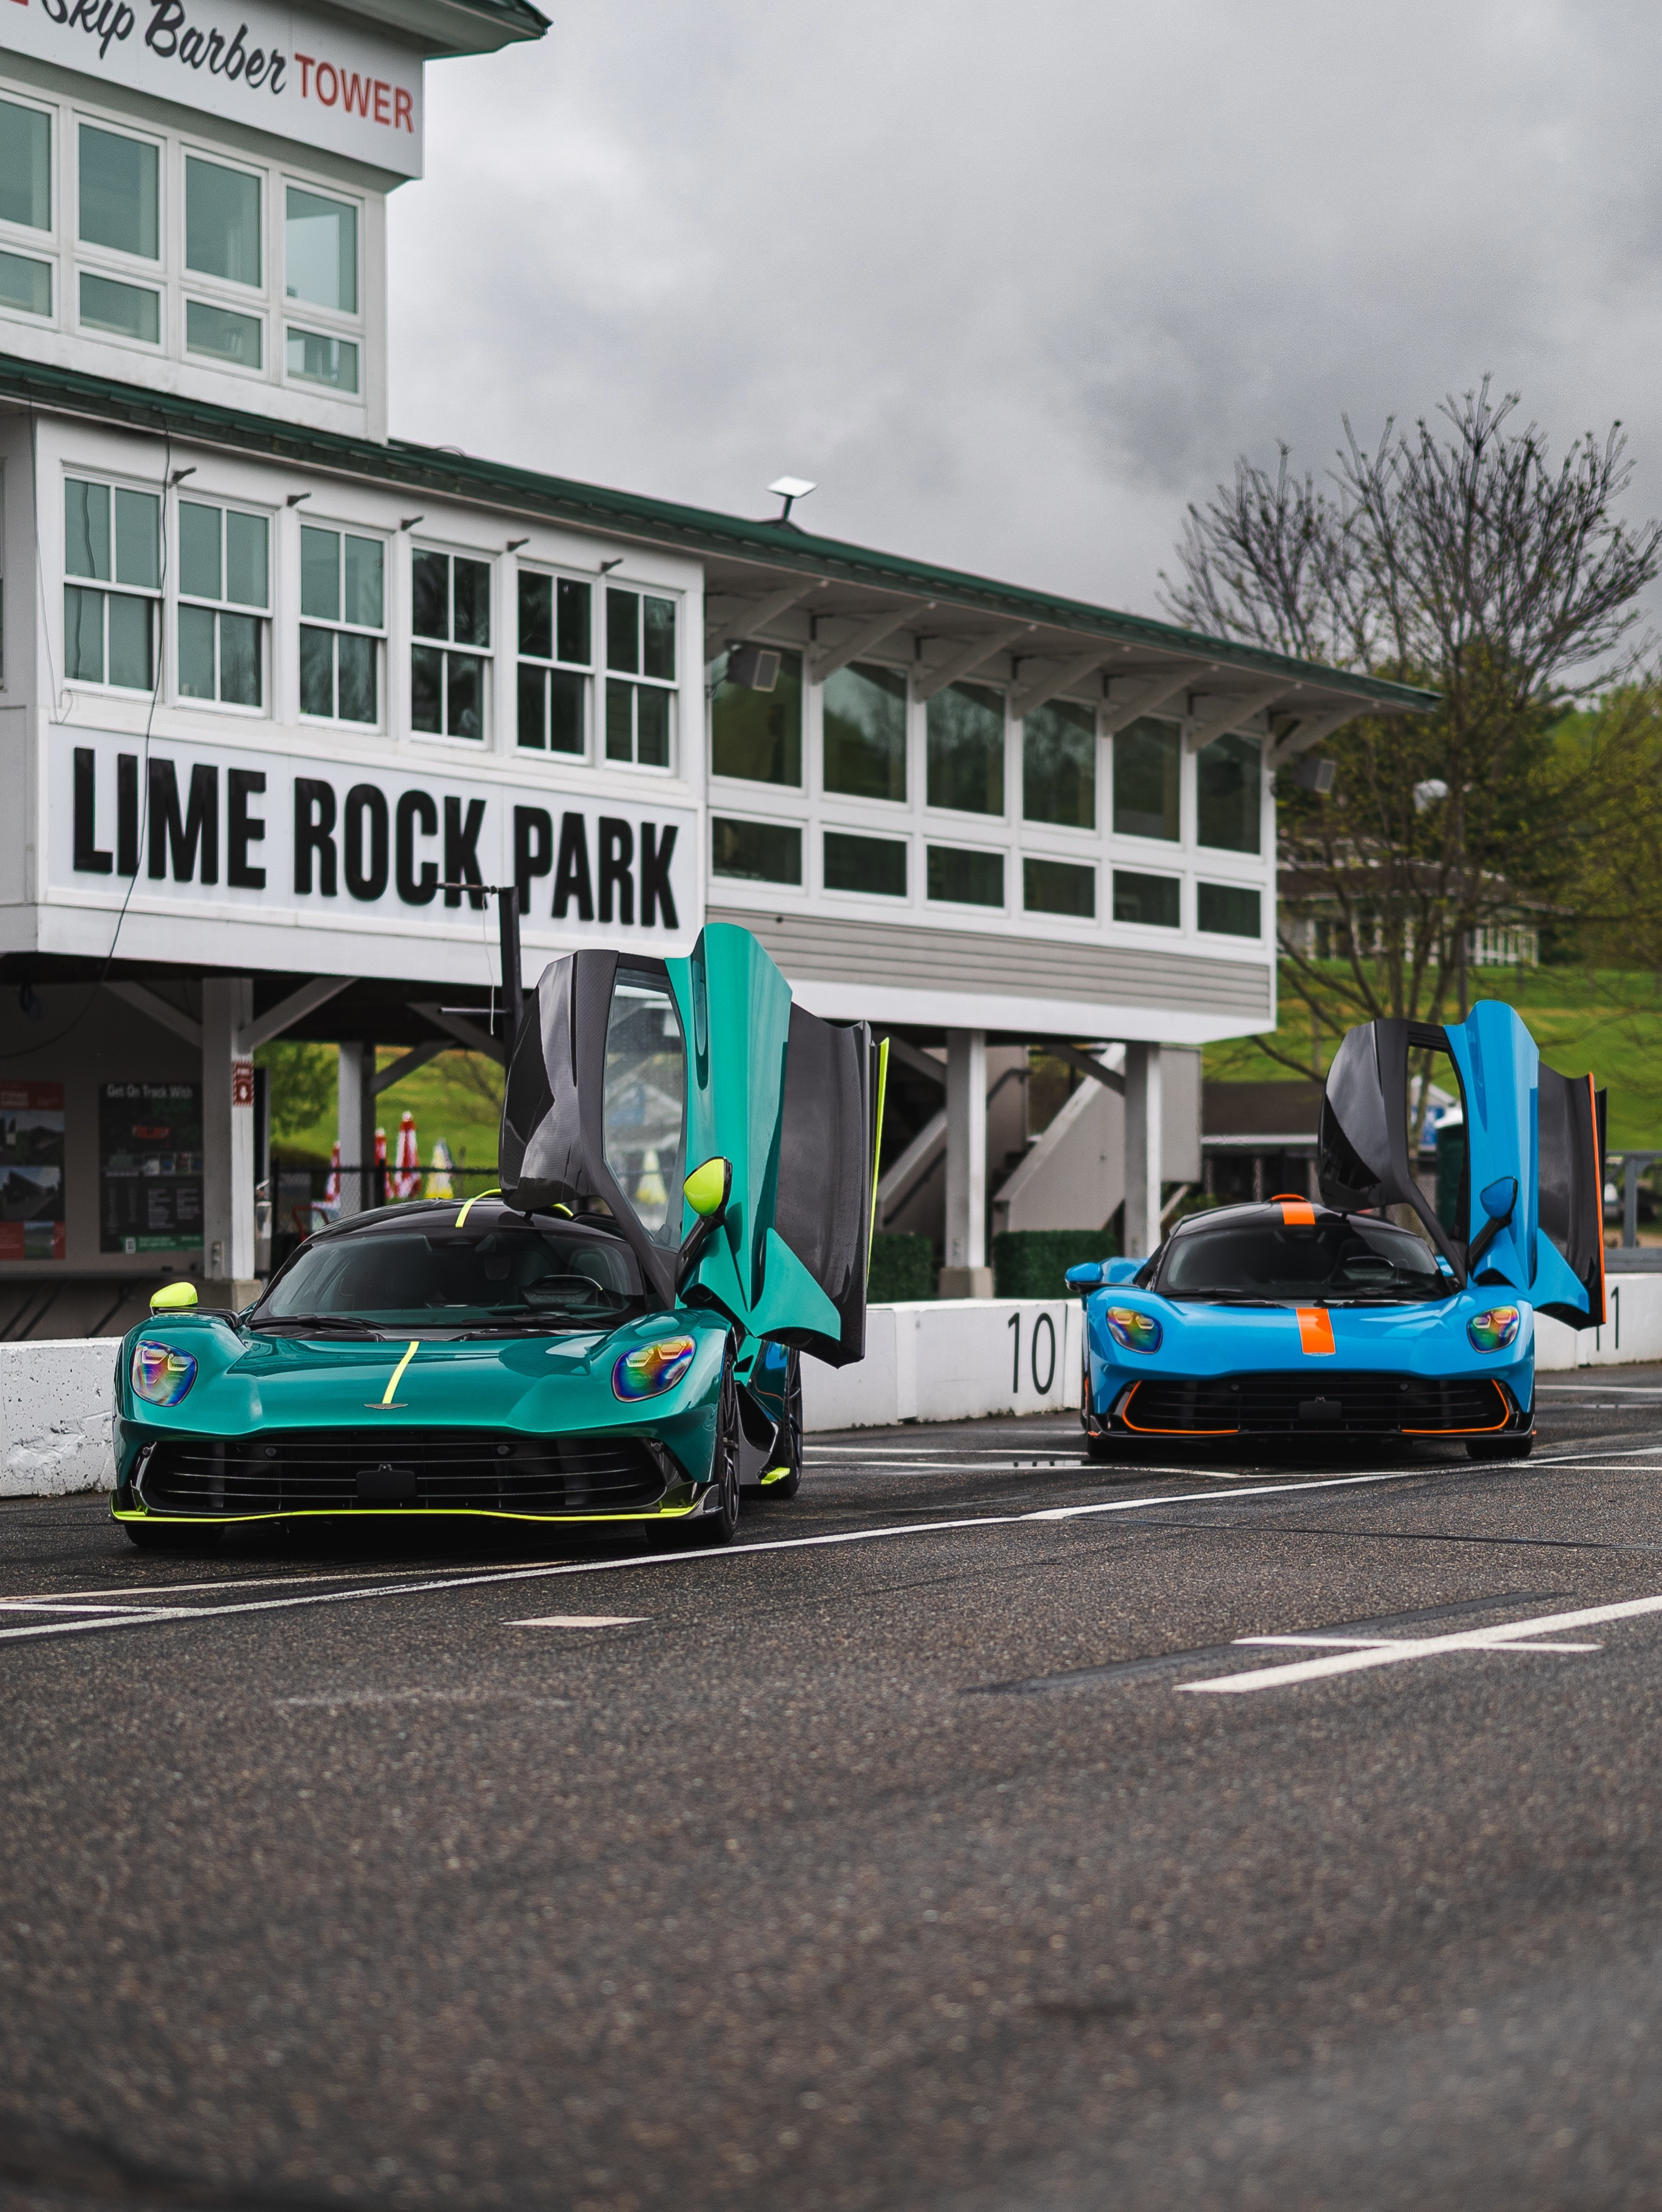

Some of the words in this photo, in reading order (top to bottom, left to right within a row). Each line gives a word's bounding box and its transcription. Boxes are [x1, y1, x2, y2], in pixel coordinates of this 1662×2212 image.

[145, 0, 286, 95] Barber
[294, 53, 415, 133] TOWER
[73, 747, 266, 890] LIME
[294, 777, 487, 911] ROCK
[513, 805, 679, 929] PARK
[107, 1084, 124, 1097] Get
[126, 1084, 140, 1097] On
[1008, 1312, 1056, 1395] 10
